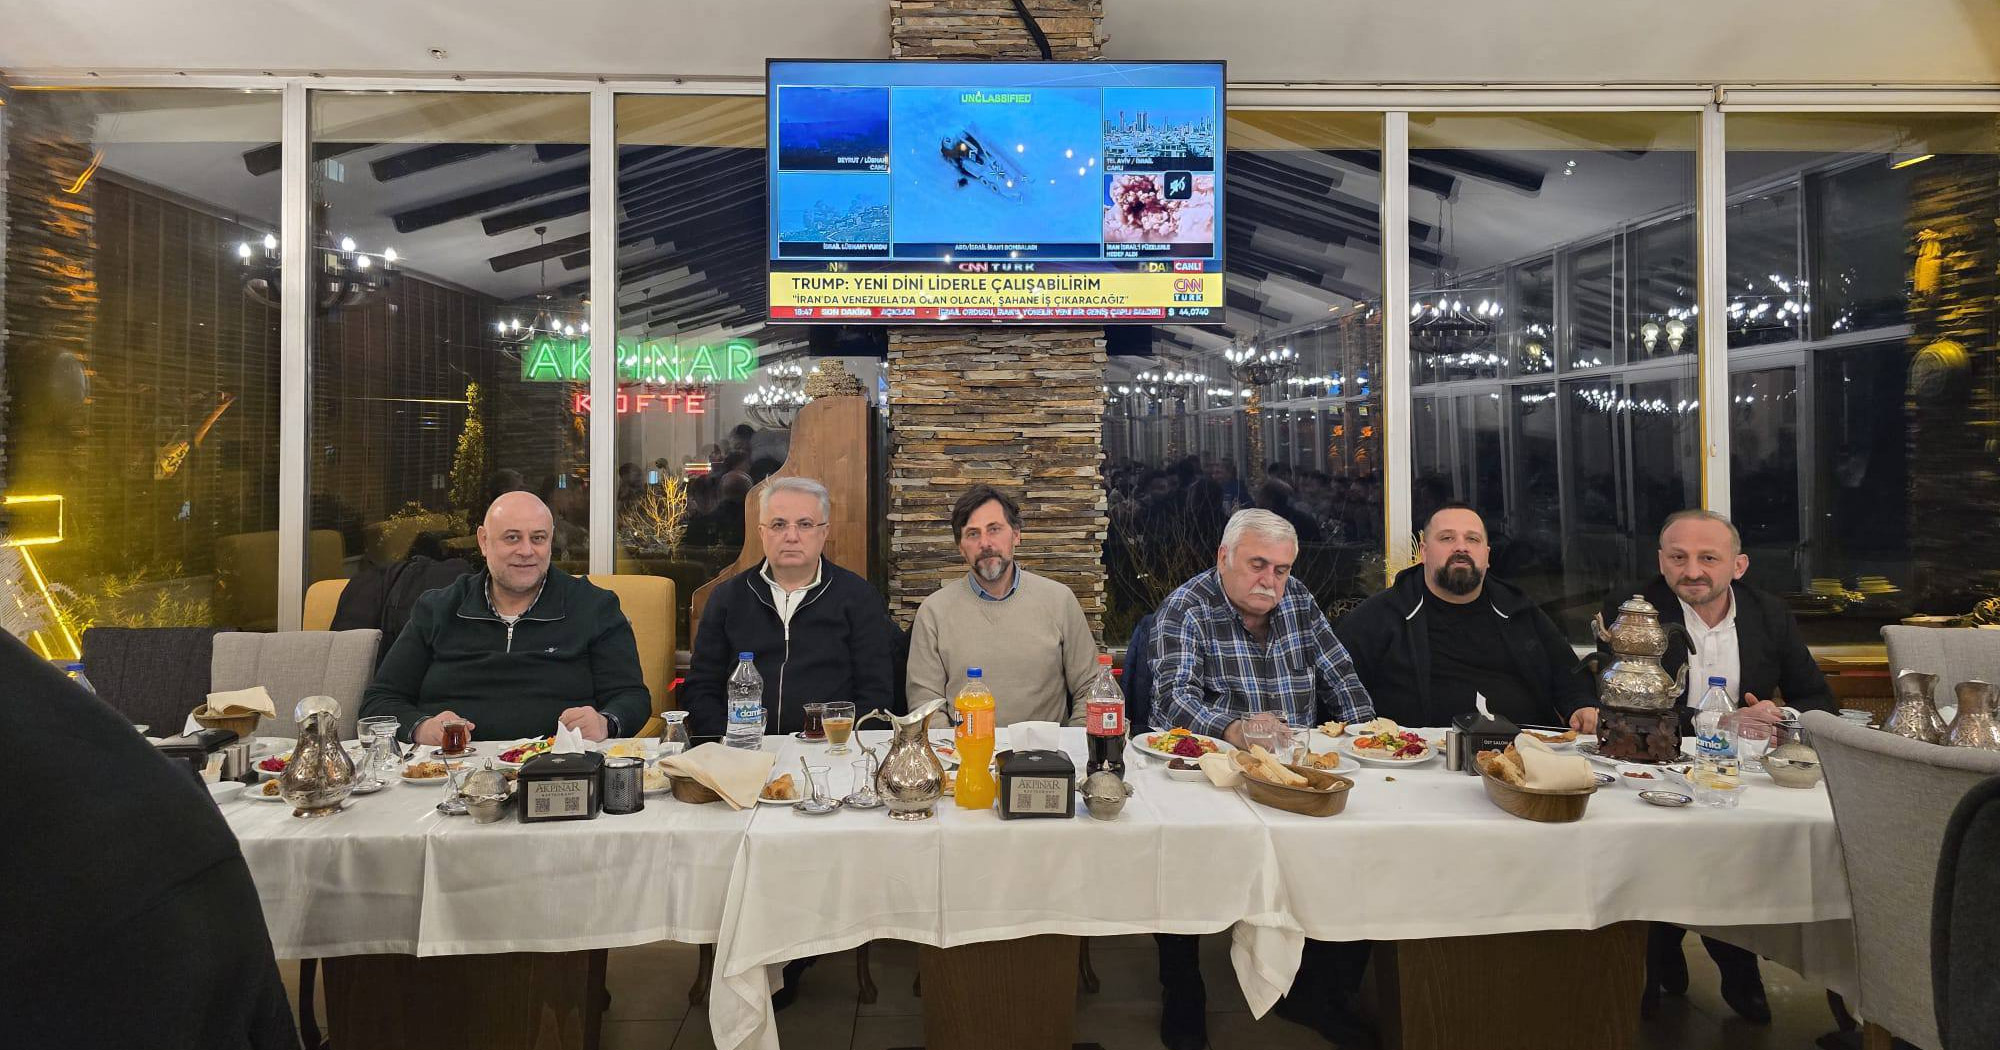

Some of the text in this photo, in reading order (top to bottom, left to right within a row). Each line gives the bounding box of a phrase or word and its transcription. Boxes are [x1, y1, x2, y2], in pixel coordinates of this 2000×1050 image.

[961, 93, 1032, 103] UNCLASSIFIED
[958, 262, 989, 272] CNN
[1174, 262, 1202, 271] CANLI
[791, 275, 1101, 293] TRUMP: YENİ DİNİ LİDERLE ÇALIŞABİLİRİM
[1173, 278, 1203, 292] CNN
[841, 295, 916, 304] VENEZUELA'DA
[919, 295, 947, 304] OLAN
[950, 295, 995, 306] OLACAK,
[998, 295, 1039, 306] ŞAHANE
[1041, 293, 1051, 306] İŞ
[821, 308, 840, 316] SON
